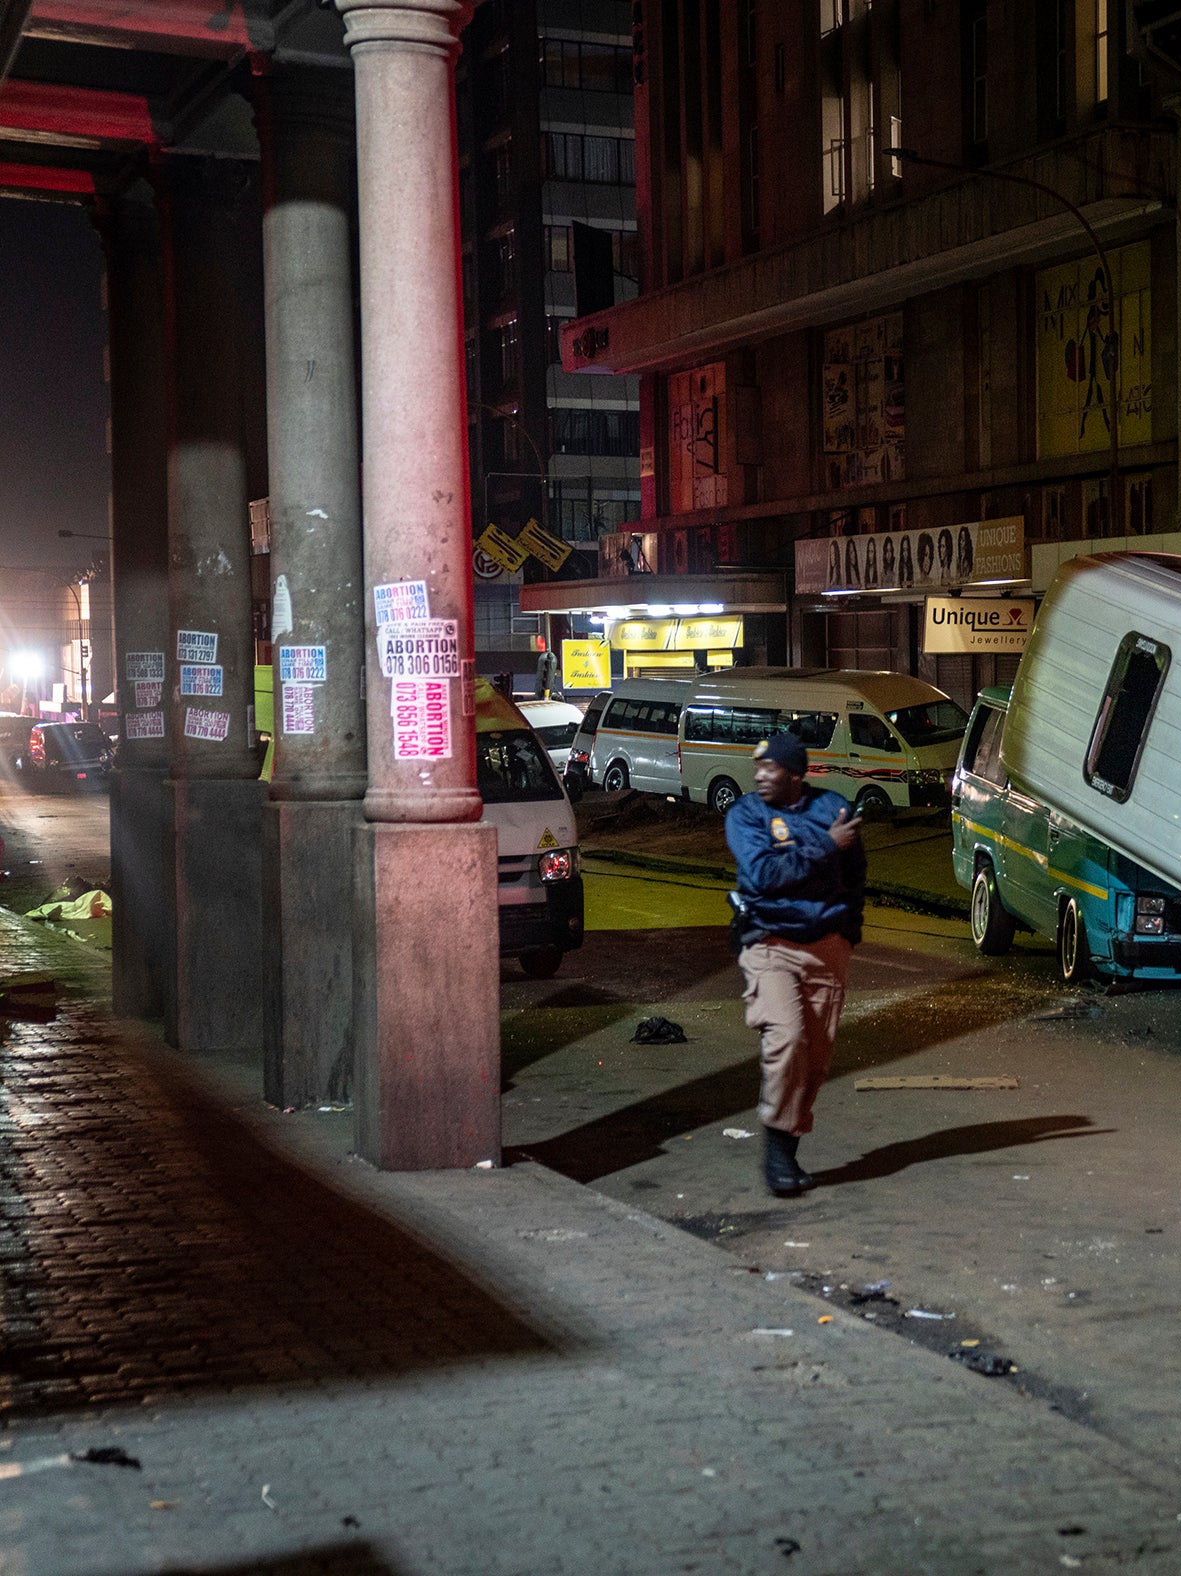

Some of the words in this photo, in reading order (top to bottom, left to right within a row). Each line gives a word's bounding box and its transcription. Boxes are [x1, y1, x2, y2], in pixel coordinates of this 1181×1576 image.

[980, 525, 1017, 547] UNIQUE
[976, 553, 1021, 574] FASHIONS
[376, 584, 424, 600] ABORTION
[377, 609, 389, 623] 078
[391, 606, 404, 621] 076
[406, 604, 427, 619] 0222
[933, 607, 1000, 631] Unique
[178, 633, 216, 646] ABORTION
[386, 638, 457, 654] ABORTION
[970, 635, 1027, 646] Jewellery
[127, 654, 163, 662] ABORTION
[281, 648, 324, 658] ABORTION
[182, 667, 222, 677] ABORTION
[292, 667, 304, 679] 076
[306, 667, 325, 679] 0222
[386, 655, 404, 675] 078
[408, 655, 430, 675] 306
[433, 654, 457, 674] 0156
[396, 682, 417, 702] 073
[188, 708, 228, 720] ABORTION
[304, 686, 315, 732] ABORTION
[396, 705, 418, 727] 856
[425, 682, 444, 756] ABORTION
[397, 730, 419, 757] 1548
